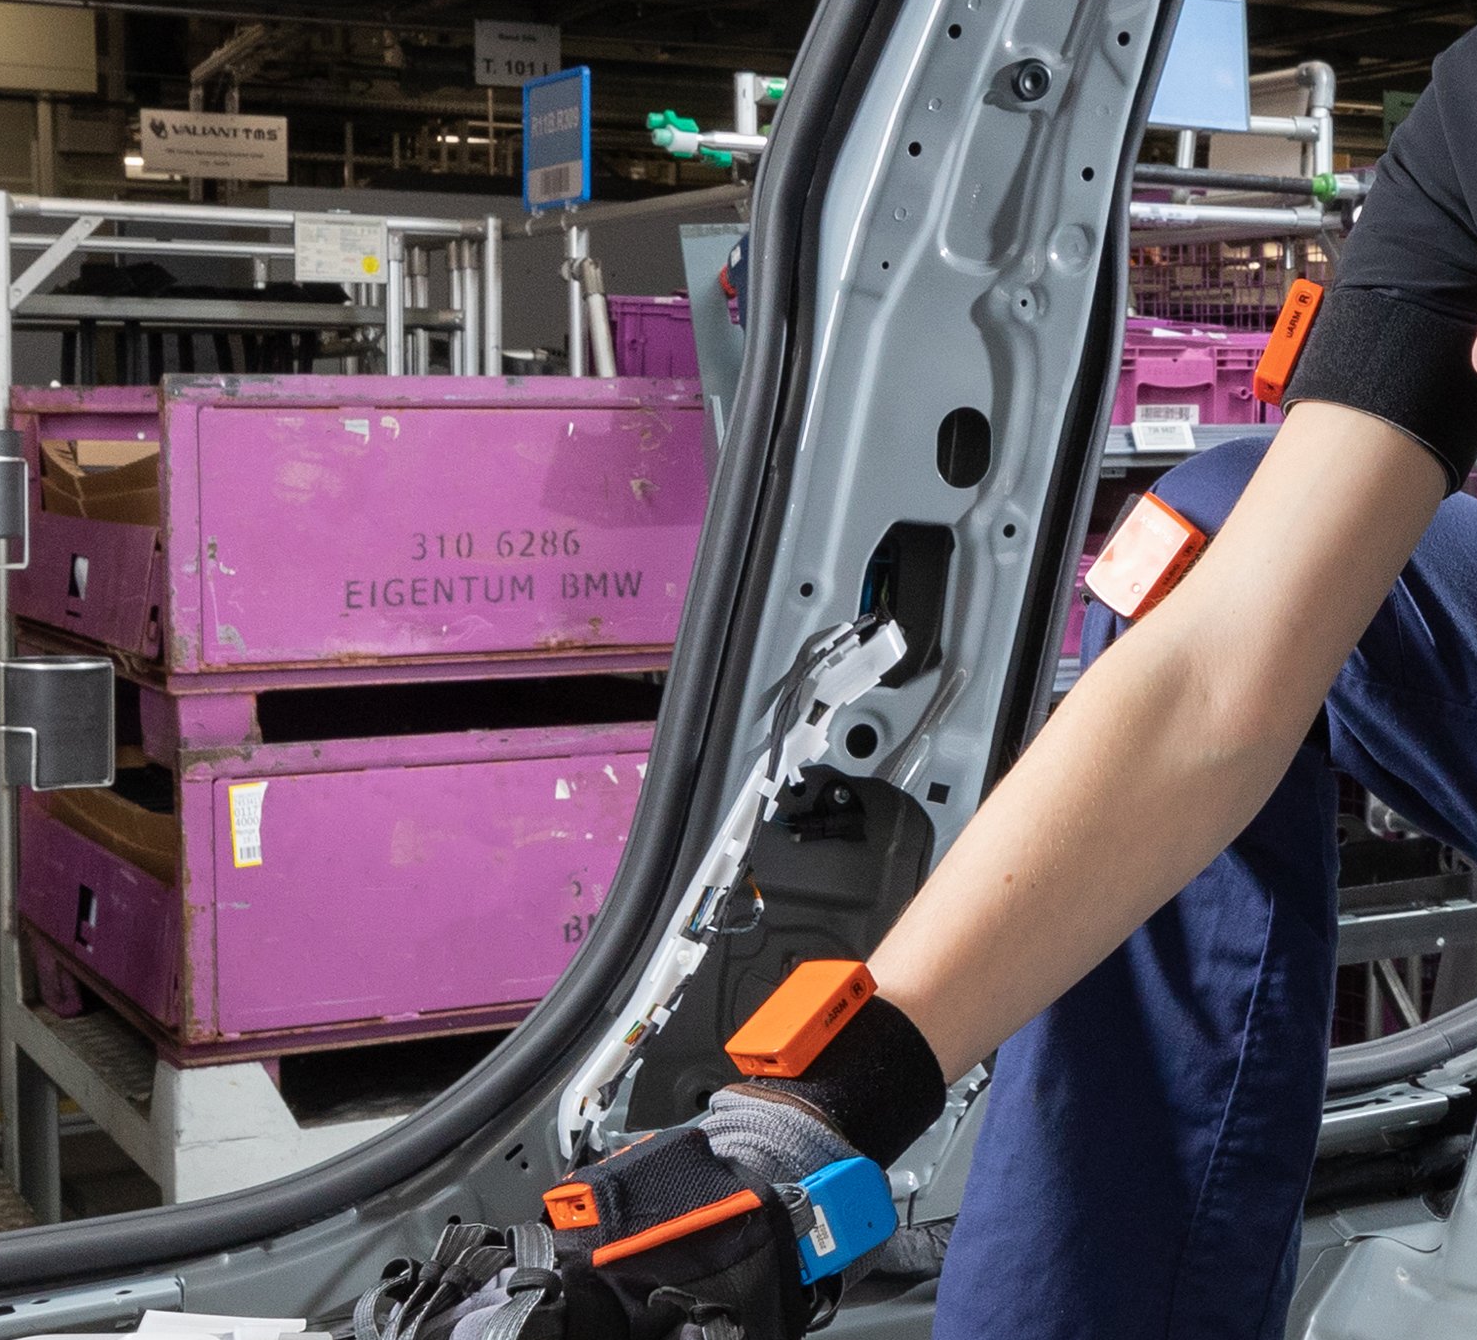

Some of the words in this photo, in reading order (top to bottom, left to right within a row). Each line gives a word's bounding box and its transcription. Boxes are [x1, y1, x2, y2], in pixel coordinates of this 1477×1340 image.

[505, 60, 535, 76] 101
[172, 124, 239, 139] VALIANT
[412, 532, 473, 560] 310
[496, 529, 581, 558] 6286
[345, 574, 534, 609] EIGENTUM
[561, 571, 643, 600] BMW
